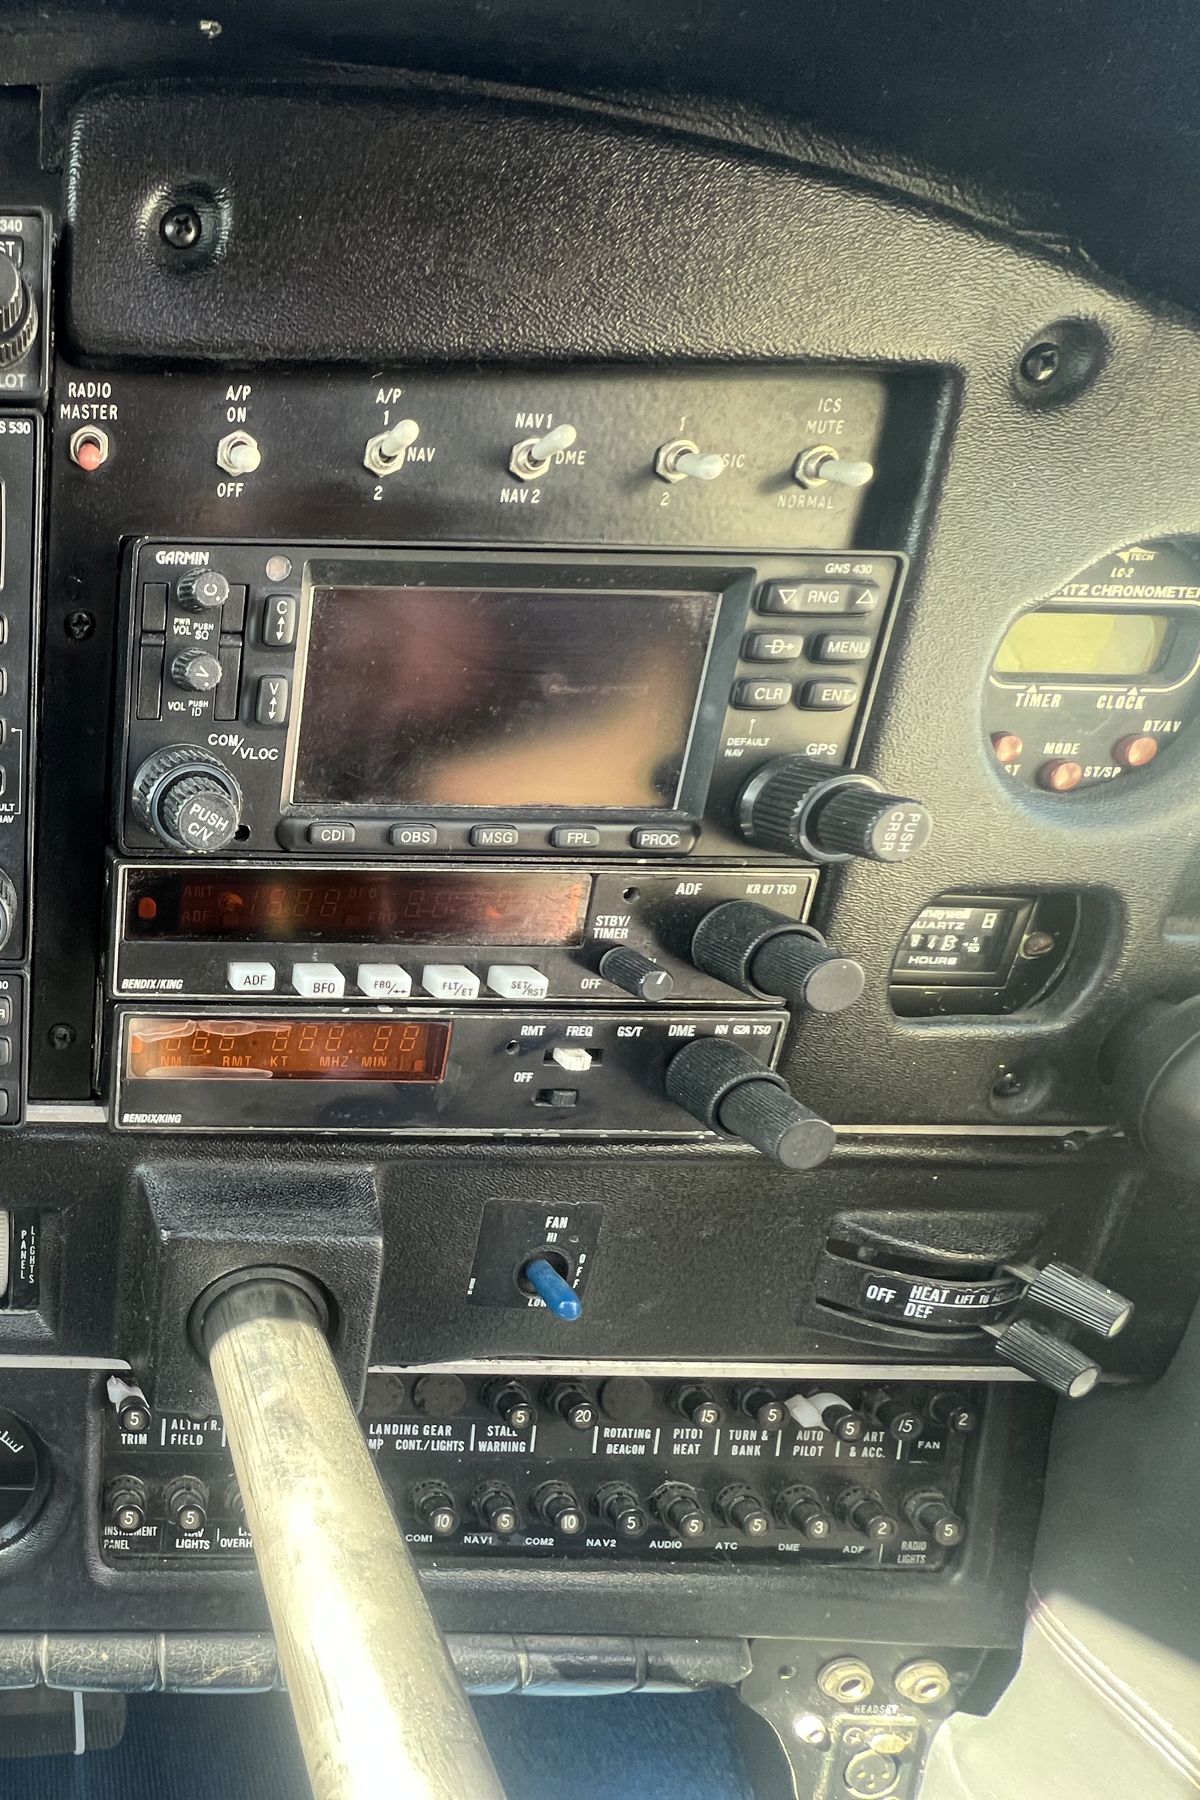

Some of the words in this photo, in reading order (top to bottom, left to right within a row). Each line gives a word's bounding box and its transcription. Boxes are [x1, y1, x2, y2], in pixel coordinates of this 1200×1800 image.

[68, 383, 111, 398] RADIO
[226, 385, 251, 400] A/P
[376, 389, 401, 403] A/P
[60, 405, 118, 419] MASTER
[227, 407, 246, 422] ON
[9, 422, 30, 434] 530
[805, 420, 843, 434] MUTE
[408, 448, 435, 461] NAV
[555, 450, 587, 465] DME
[217, 483, 244, 497] OFF
[777, 494, 834, 508] NORMAL
[156, 551, 209, 565] GARMIN
[808, 591, 839, 603] RNG
[173, 625, 191, 636] VOL
[828, 642, 869, 653] MENU
[754, 688, 783, 700] CLR
[822, 689, 851, 701] ENT
[168, 702, 186, 711] VOL
[1016, 694, 1061, 707] TIMER
[1096, 696, 1145, 709] CLOCK
[806, 744, 837, 755] GPS
[1043, 743, 1079, 755] MODE
[190, 804, 228, 830] PUSH
[188, 822, 213, 841] C/V
[401, 831, 430, 843] OBS
[482, 831, 512, 843] MSG
[567, 831, 590, 843] FPL
[641, 833, 679, 845] PROC
[675, 883, 702, 895] ADF
[593, 927, 628, 939] TIMER
[908, 956, 957, 964] HOURS
[122, 979, 183, 990] BENDIX/KING
[244, 975, 267, 985] ADF
[443, 982, 473, 996] FLT/ET
[511, 980, 544, 996] SET/RST
[567, 1026, 592, 1037] FREQ
[617, 1026, 643, 1037] GS/T
[668, 1025, 696, 1036] DME
[320, 1056, 347, 1067] MHZ
[362, 1056, 387, 1067] MIN
[545, 1217, 568, 1228] FAN
[867, 1285, 897, 1303] OFF
[910, 1285, 950, 1303] HEAT
[576, 1410, 591, 1422] 20
[702, 1410, 714, 1422] 15
[369, 1424, 419, 1435] LANDING
[423, 1425, 452, 1436] GEAR
[899, 1420, 913, 1432] 15
[121, 1434, 147, 1444] TRIM
[171, 1434, 203, 1445] FIELD
[603, 1428, 651, 1439] ROTATING
[673, 1428, 703, 1440] PITOT
[797, 1430, 823, 1441] AUTO
[478, 1441, 526, 1452] WARNING
[606, 1444, 645, 1455] BEACON
[673, 1444, 700, 1455] HEAT
[732, 1444, 761, 1456] BANK
[793, 1445, 823, 1457] PILOT
[918, 1441, 940, 1449] FAN
[436, 1515, 449, 1528] 10
[563, 1515, 576, 1527] 10
[176, 1539, 210, 1550] LIGHTS
[650, 1541, 682, 1549] AUDIO
[715, 1542, 738, 1550] ATC
